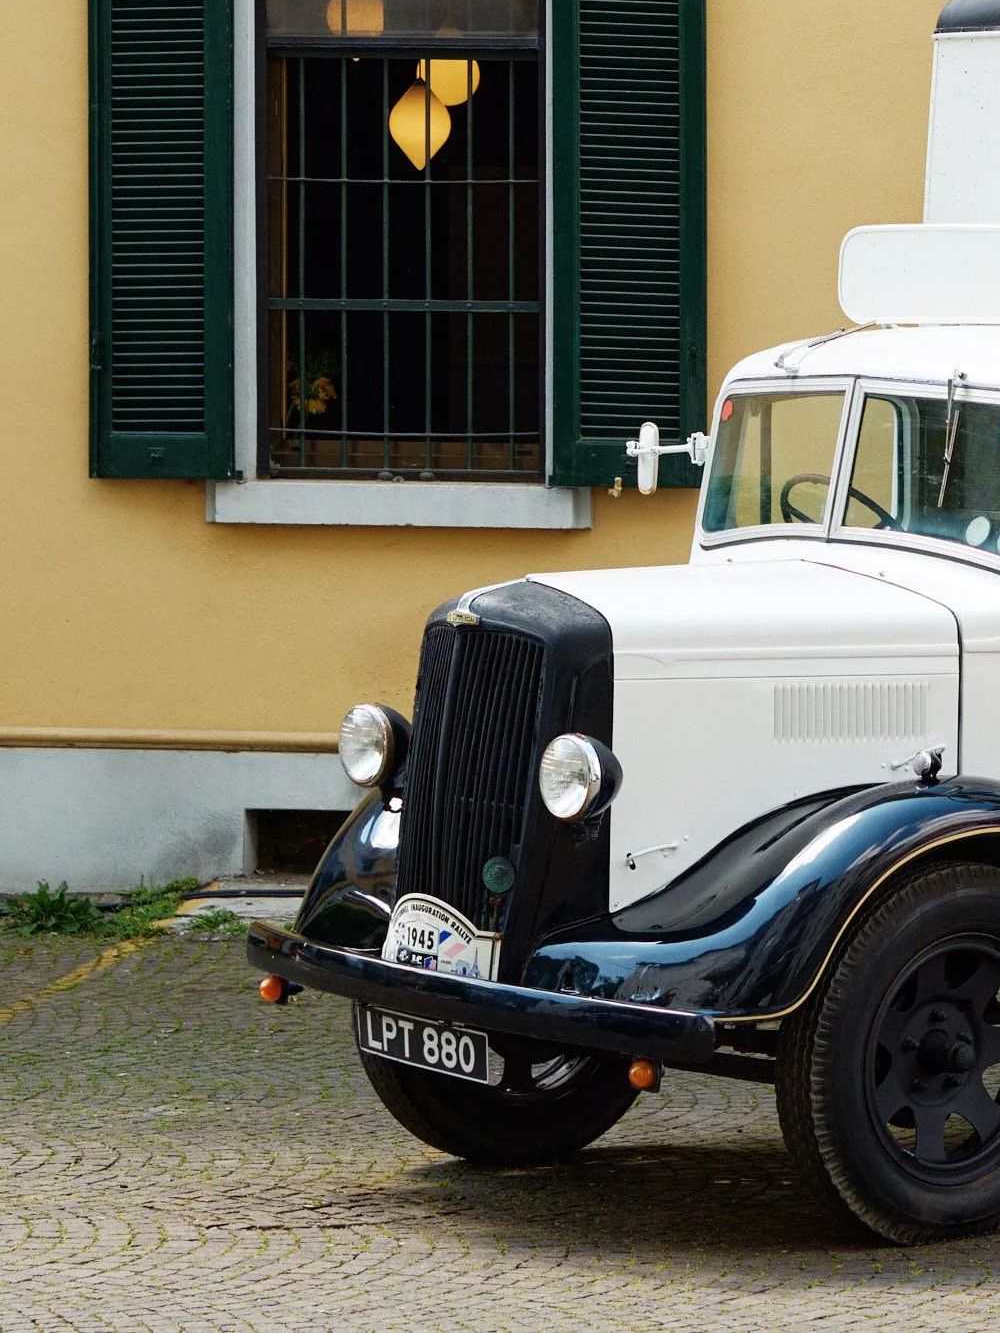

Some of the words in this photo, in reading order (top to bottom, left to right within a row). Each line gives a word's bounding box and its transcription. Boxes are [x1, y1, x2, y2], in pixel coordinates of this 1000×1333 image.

[407, 926, 434, 949] 1945
[410, 903, 450, 924] INAUGURATION
[450, 921, 473, 945] RALLYE
[366, 1010, 414, 1058] LPT
[422, 1026, 475, 1073] 880
